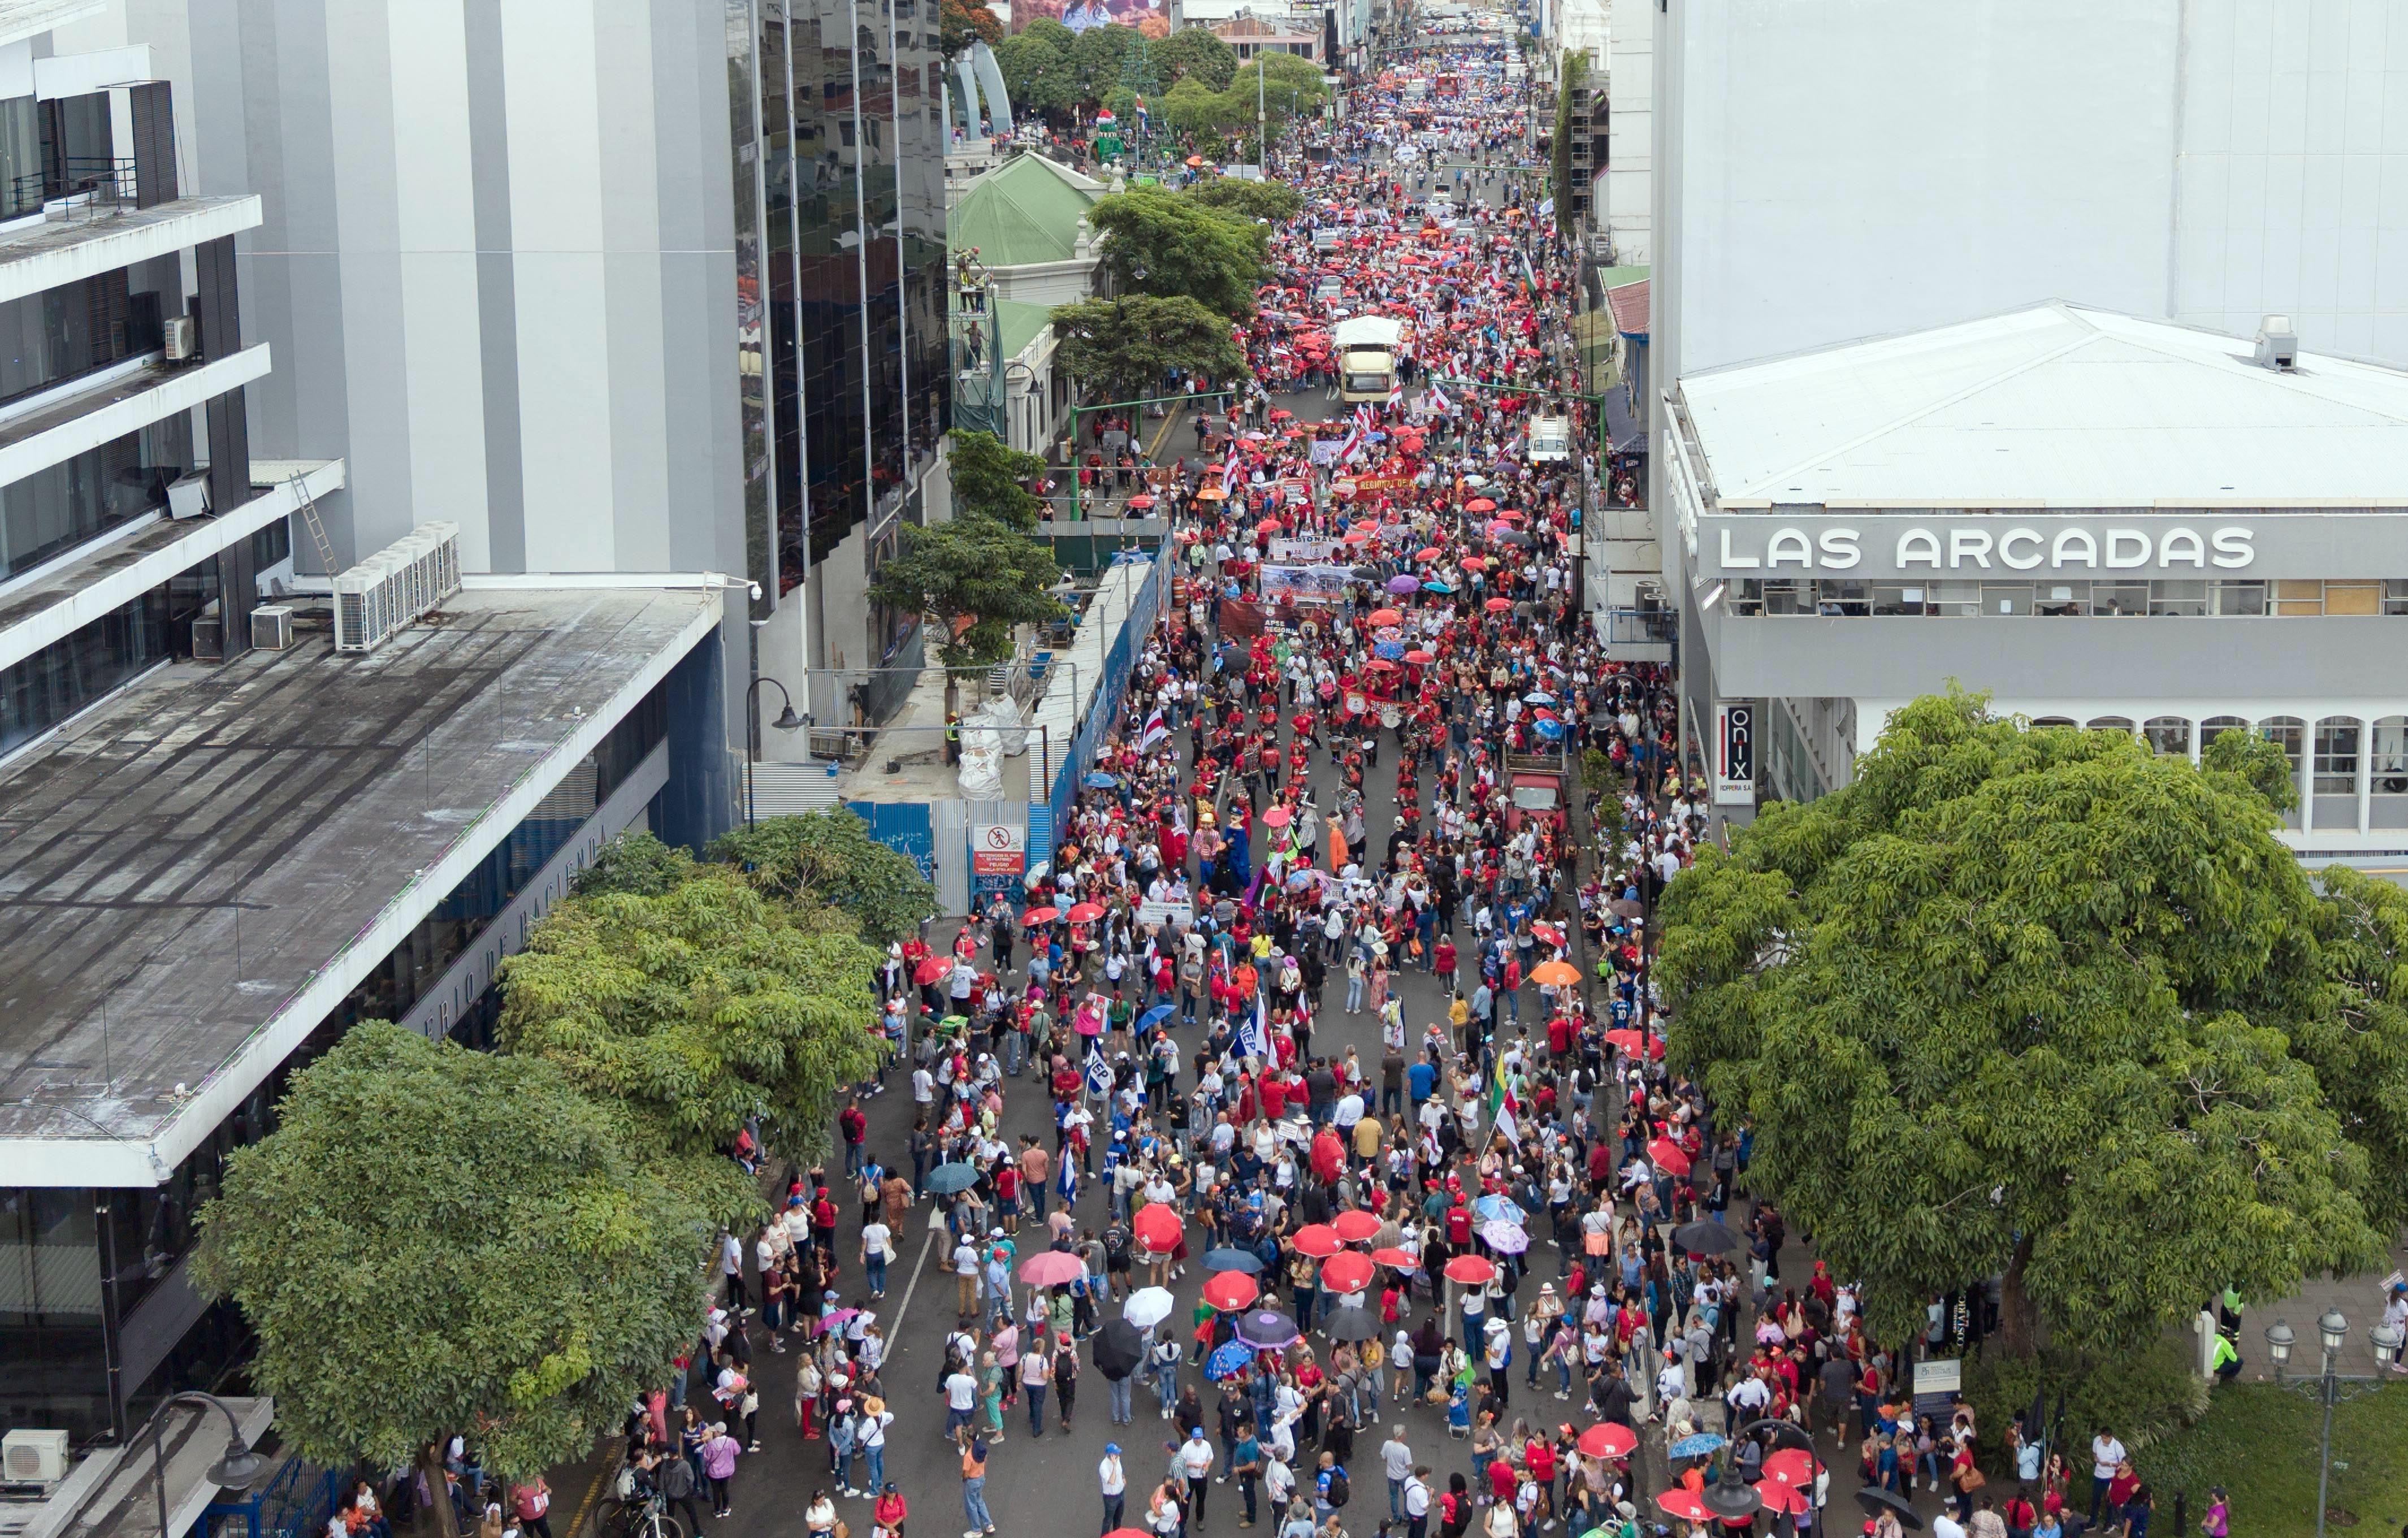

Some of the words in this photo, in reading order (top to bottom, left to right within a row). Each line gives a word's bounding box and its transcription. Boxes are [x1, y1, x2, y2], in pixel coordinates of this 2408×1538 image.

[1721, 528, 1861, 569] LAS
[1897, 527, 2254, 569] ARCADAS
[1617, 1009, 1627, 1020] 10
[1957, 1296, 1967, 1313] RIC
